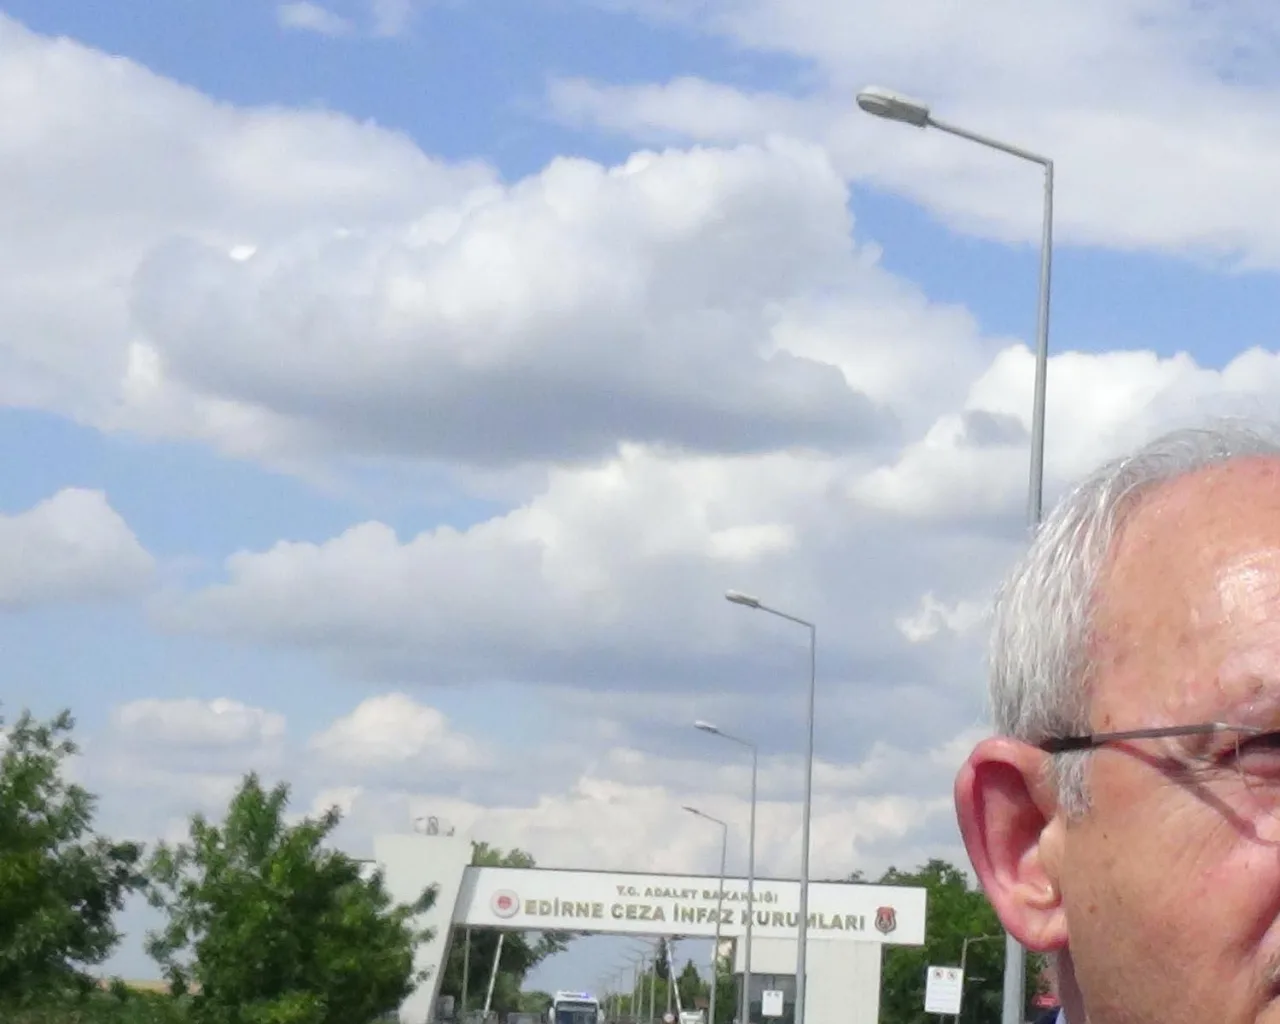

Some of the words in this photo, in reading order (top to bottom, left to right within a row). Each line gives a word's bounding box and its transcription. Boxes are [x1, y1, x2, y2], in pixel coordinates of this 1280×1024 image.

[645, 887, 698, 900] ADALET
[702, 888, 779, 904] BAKANLIĞI
[524, 897, 605, 919] EDİRNE
[610, 902, 666, 922] CEZA
[672, 903, 734, 926] İNFAZ
